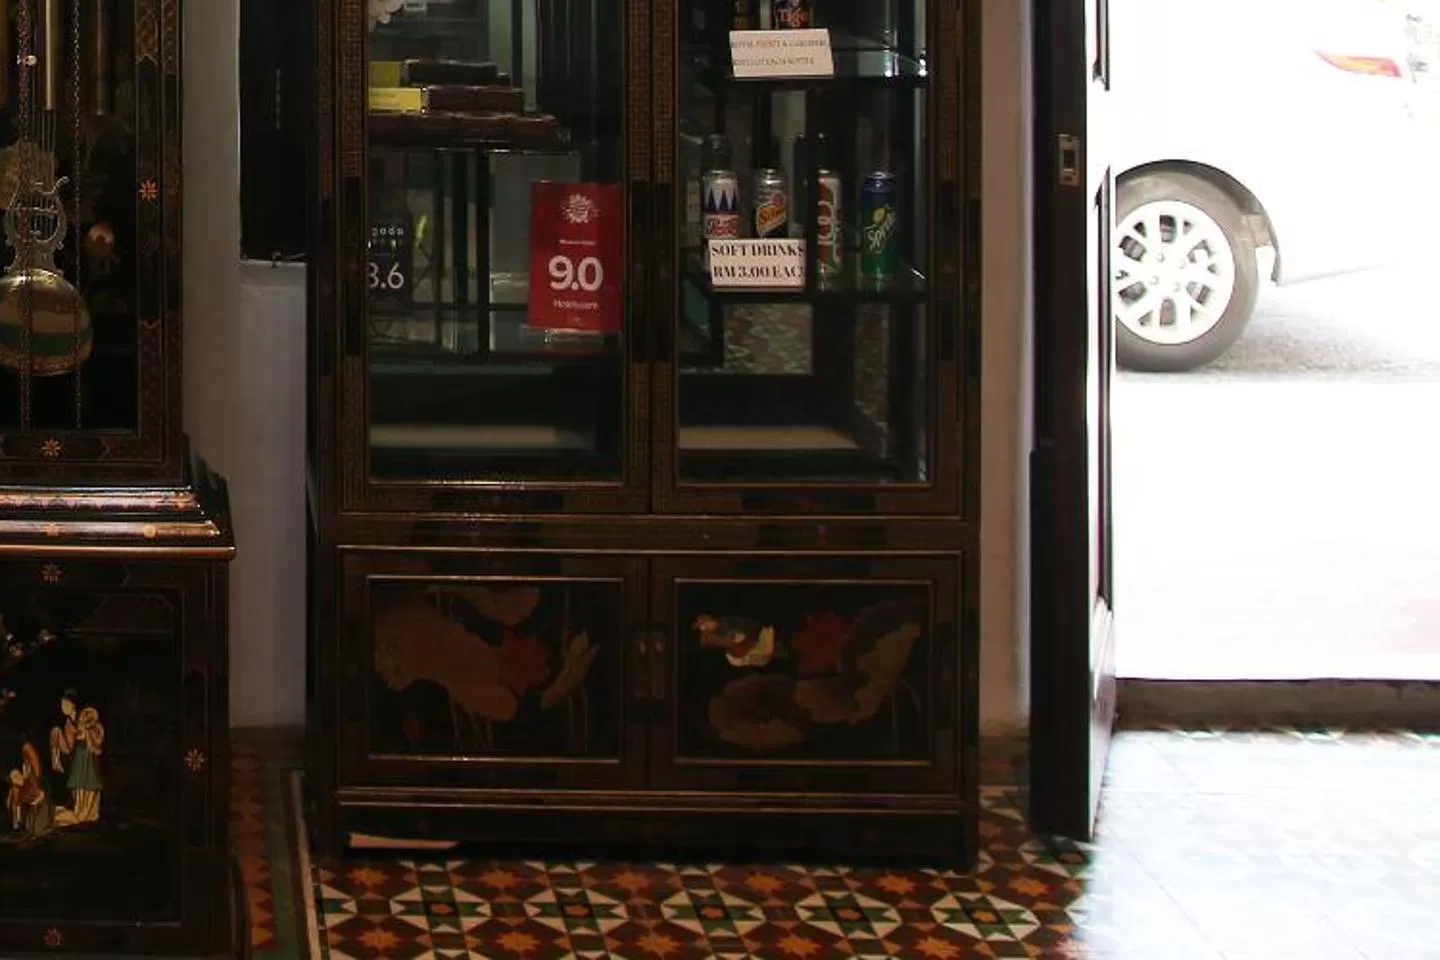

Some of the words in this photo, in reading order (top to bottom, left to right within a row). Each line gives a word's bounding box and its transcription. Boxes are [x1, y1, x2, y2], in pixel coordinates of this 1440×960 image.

[711, 243, 749, 257] SOFT
[751, 243, 804, 257] DRINKS
[548, 254, 604, 291] 9.0
[713, 265, 737, 279] RM
[739, 265, 770, 279] 3.00
